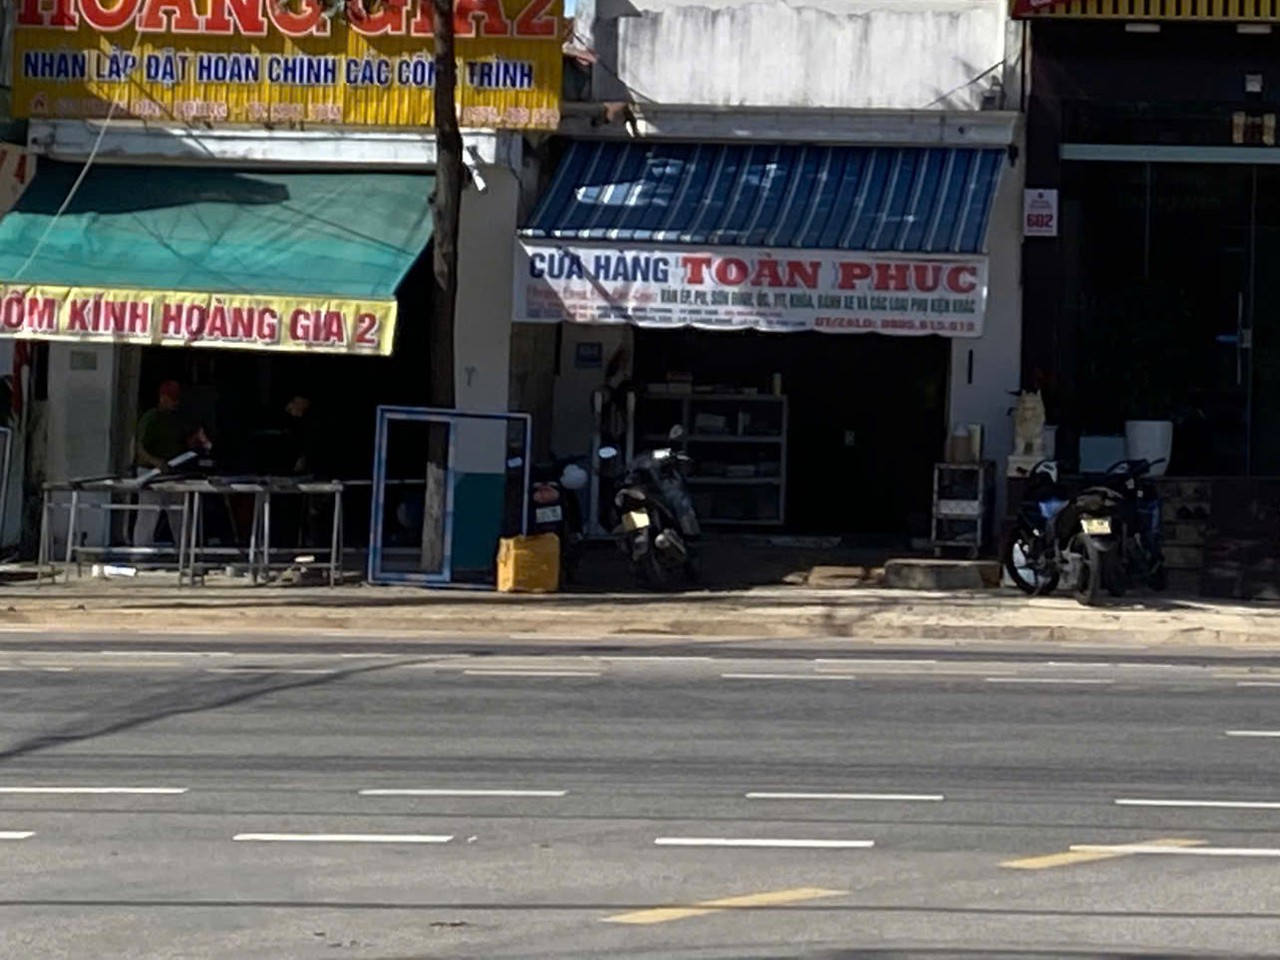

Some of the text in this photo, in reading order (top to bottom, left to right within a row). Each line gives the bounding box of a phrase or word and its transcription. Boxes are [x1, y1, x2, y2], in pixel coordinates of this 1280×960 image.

[1026, 213, 1053, 228] 602
[593, 249, 669, 283] HÀNG
[681, 251, 822, 290] TOÀN
[0, 291, 378, 344] ÔM KÍNH HOÀNG GIA 2
